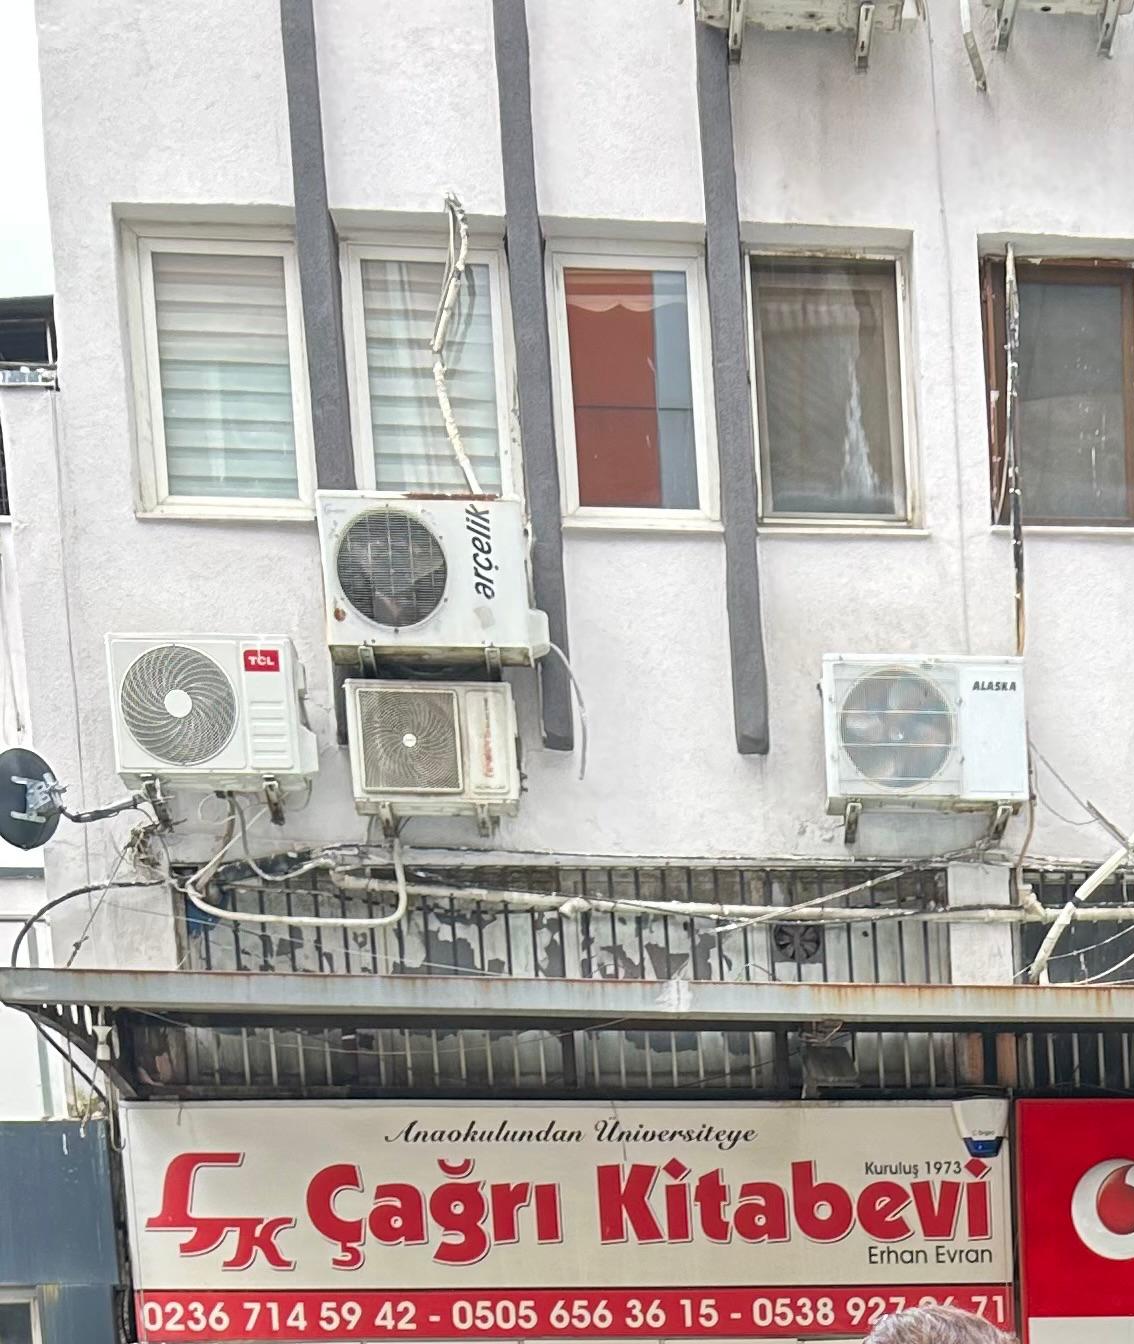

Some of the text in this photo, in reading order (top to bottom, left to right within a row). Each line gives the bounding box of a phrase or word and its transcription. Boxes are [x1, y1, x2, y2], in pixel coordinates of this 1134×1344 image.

[465, 503, 499, 600] arçelik
[247, 654, 275, 667] TCL
[972, 680, 1017, 691] ALASKA
[384, 1116, 757, 1150] Anaokulundan Üniversiteye
[865, 1160, 963, 1178] Kuruluş 1973
[306, 1157, 993, 1271] Çağrı Kitabevi
[868, 1245, 992, 1266] Erhan Evran
[143, 1302, 230, 1332] 0236
[243, 1302, 307, 1332] 714
[318, 1301, 362, 1331] 59
[374, 1301, 417, 1331] 42
[451, 1300, 538, 1330] 0505
[549, 1300, 612, 1329] 656
[625, 1299, 667, 1329] 36
[679, 1299, 719, 1328] 15
[753, 1298, 835, 1327] 0538
[846, 1297, 906, 1326] 927
[971, 1295, 1005, 1324] 71
